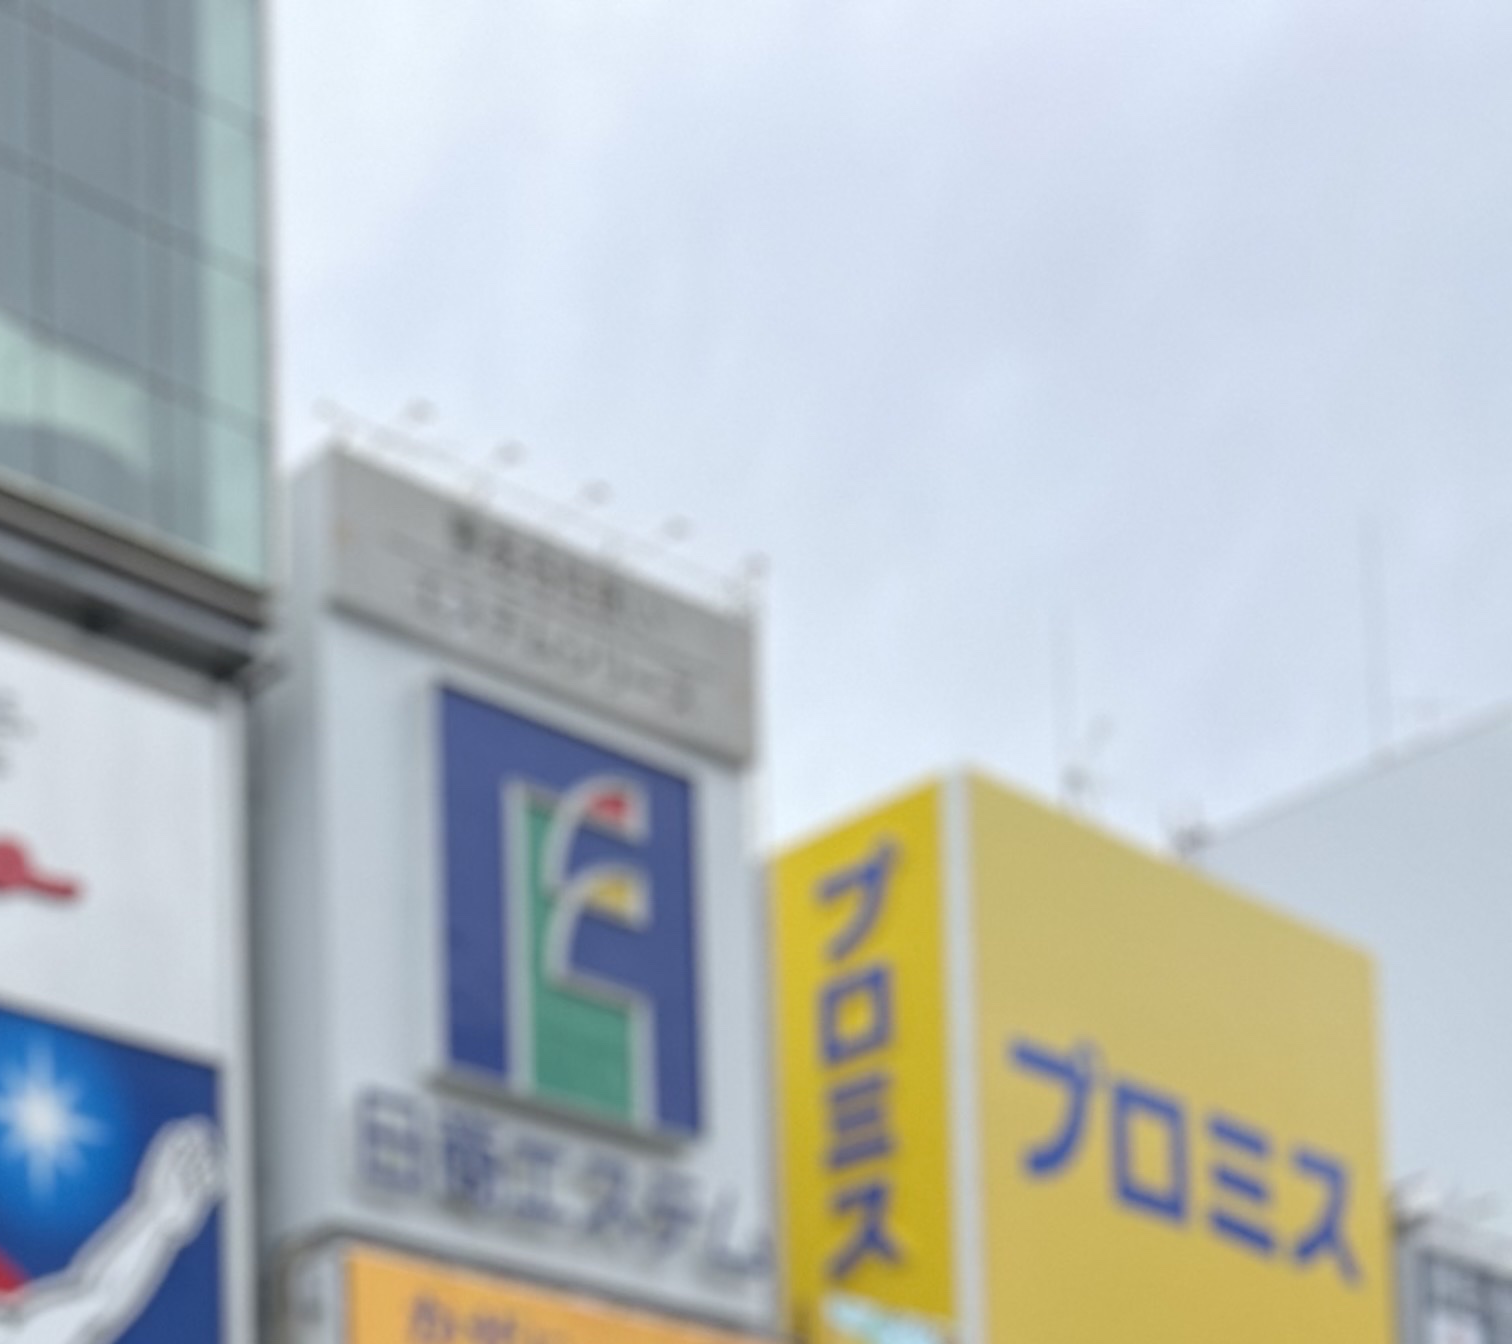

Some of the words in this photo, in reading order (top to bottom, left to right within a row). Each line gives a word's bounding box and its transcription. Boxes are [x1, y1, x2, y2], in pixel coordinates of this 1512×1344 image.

[816, 836, 904, 1281] プロミス
[1009, 1034, 1364, 1287] プロミス
